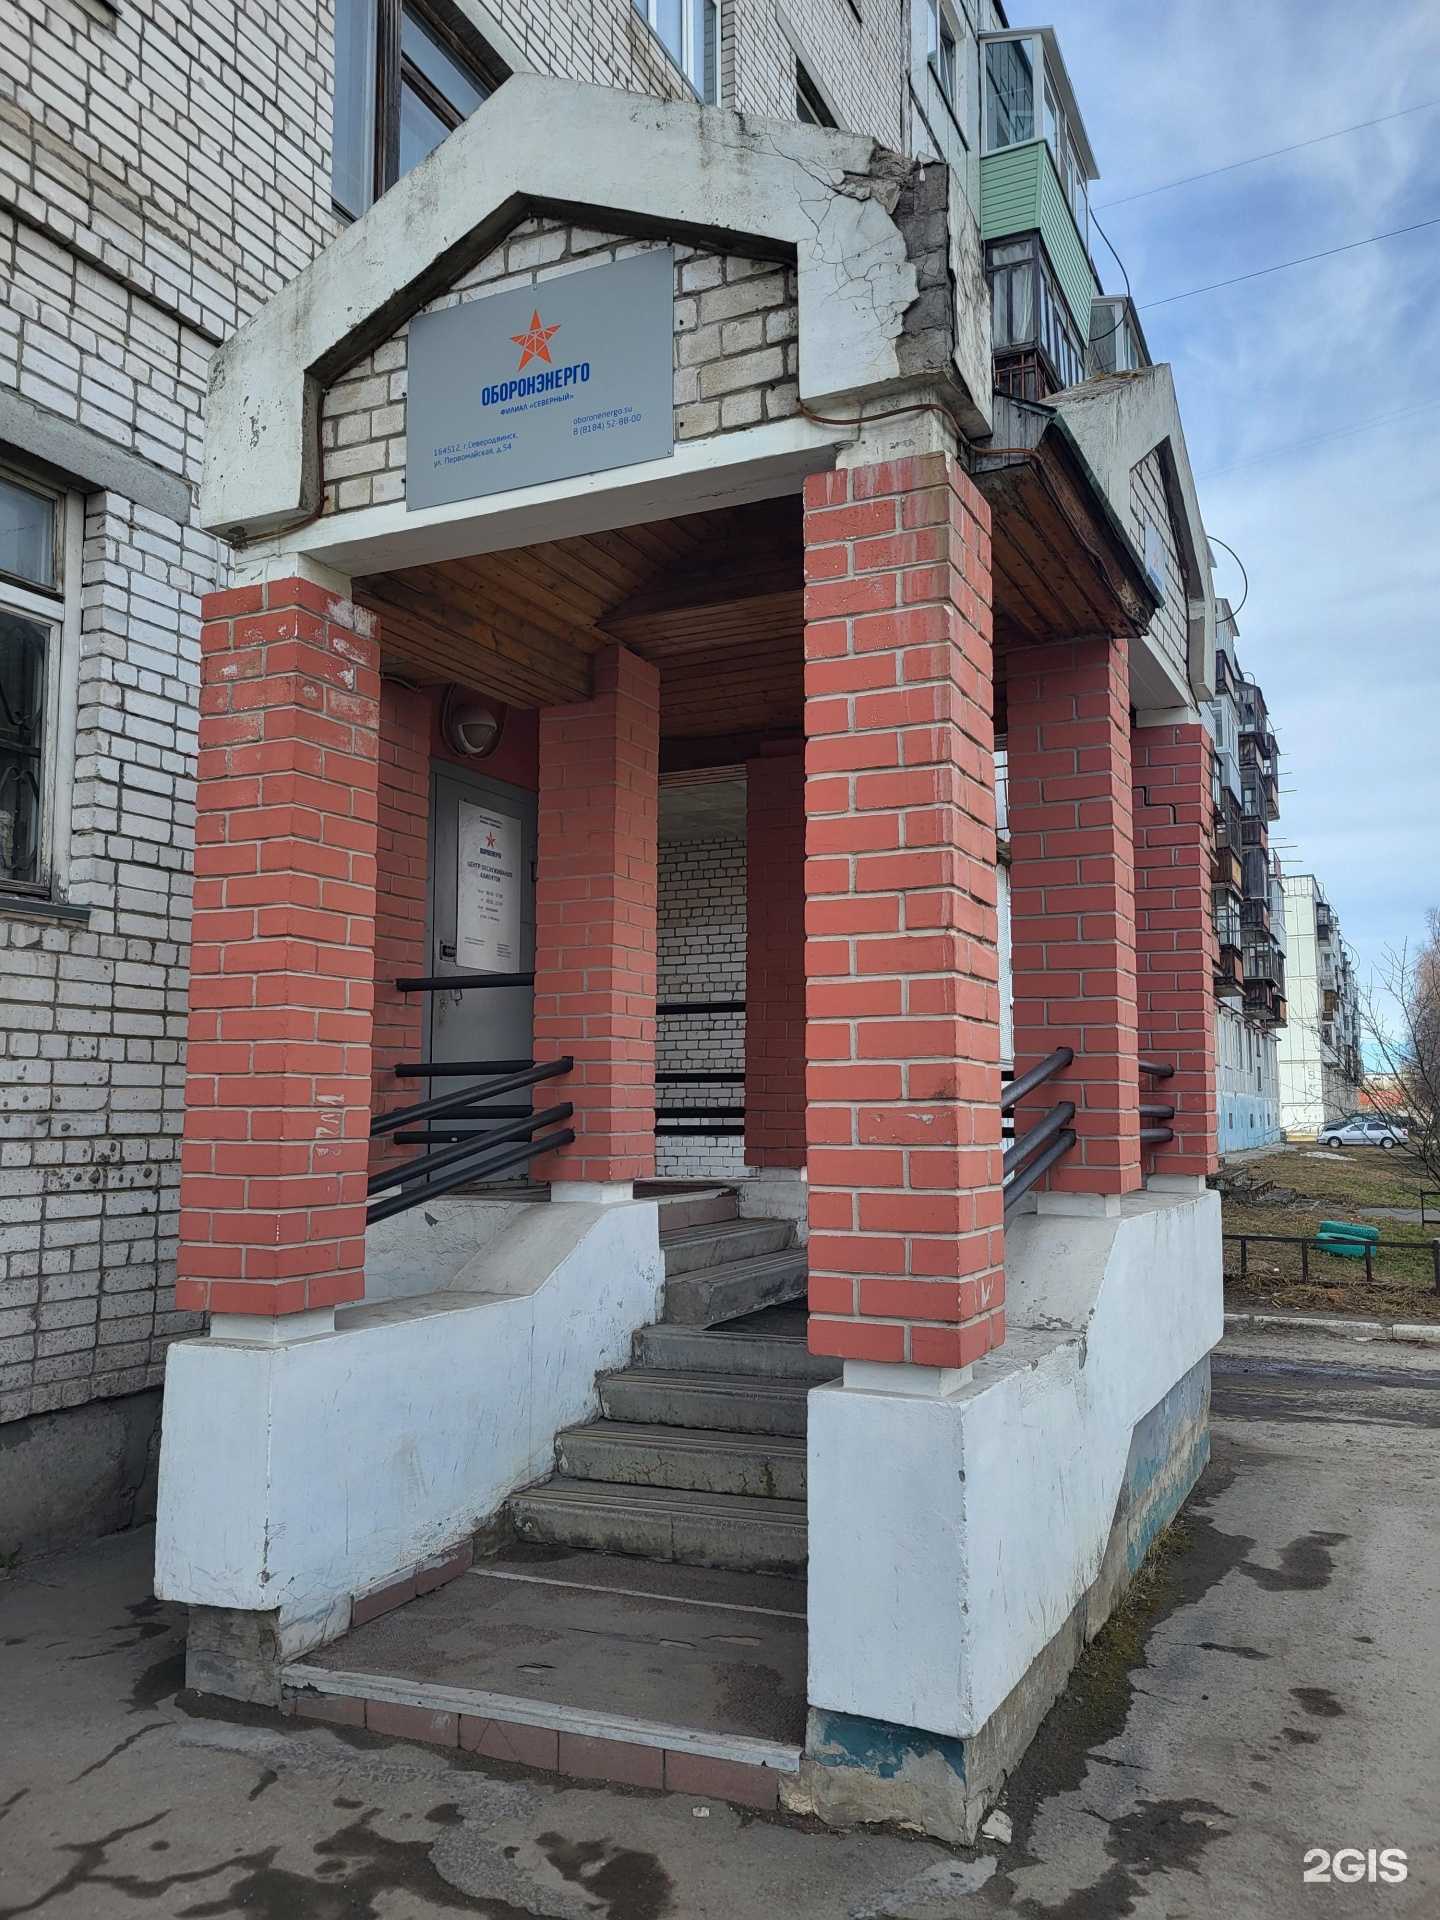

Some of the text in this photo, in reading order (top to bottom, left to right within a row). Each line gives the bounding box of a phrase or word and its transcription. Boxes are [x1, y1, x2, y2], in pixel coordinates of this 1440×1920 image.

[481, 362, 590, 406] ОБОРОНЭНЕРГО
[500, 392, 574, 415] ФИЛИАЛ «СЕВЕРНЫЙ»
